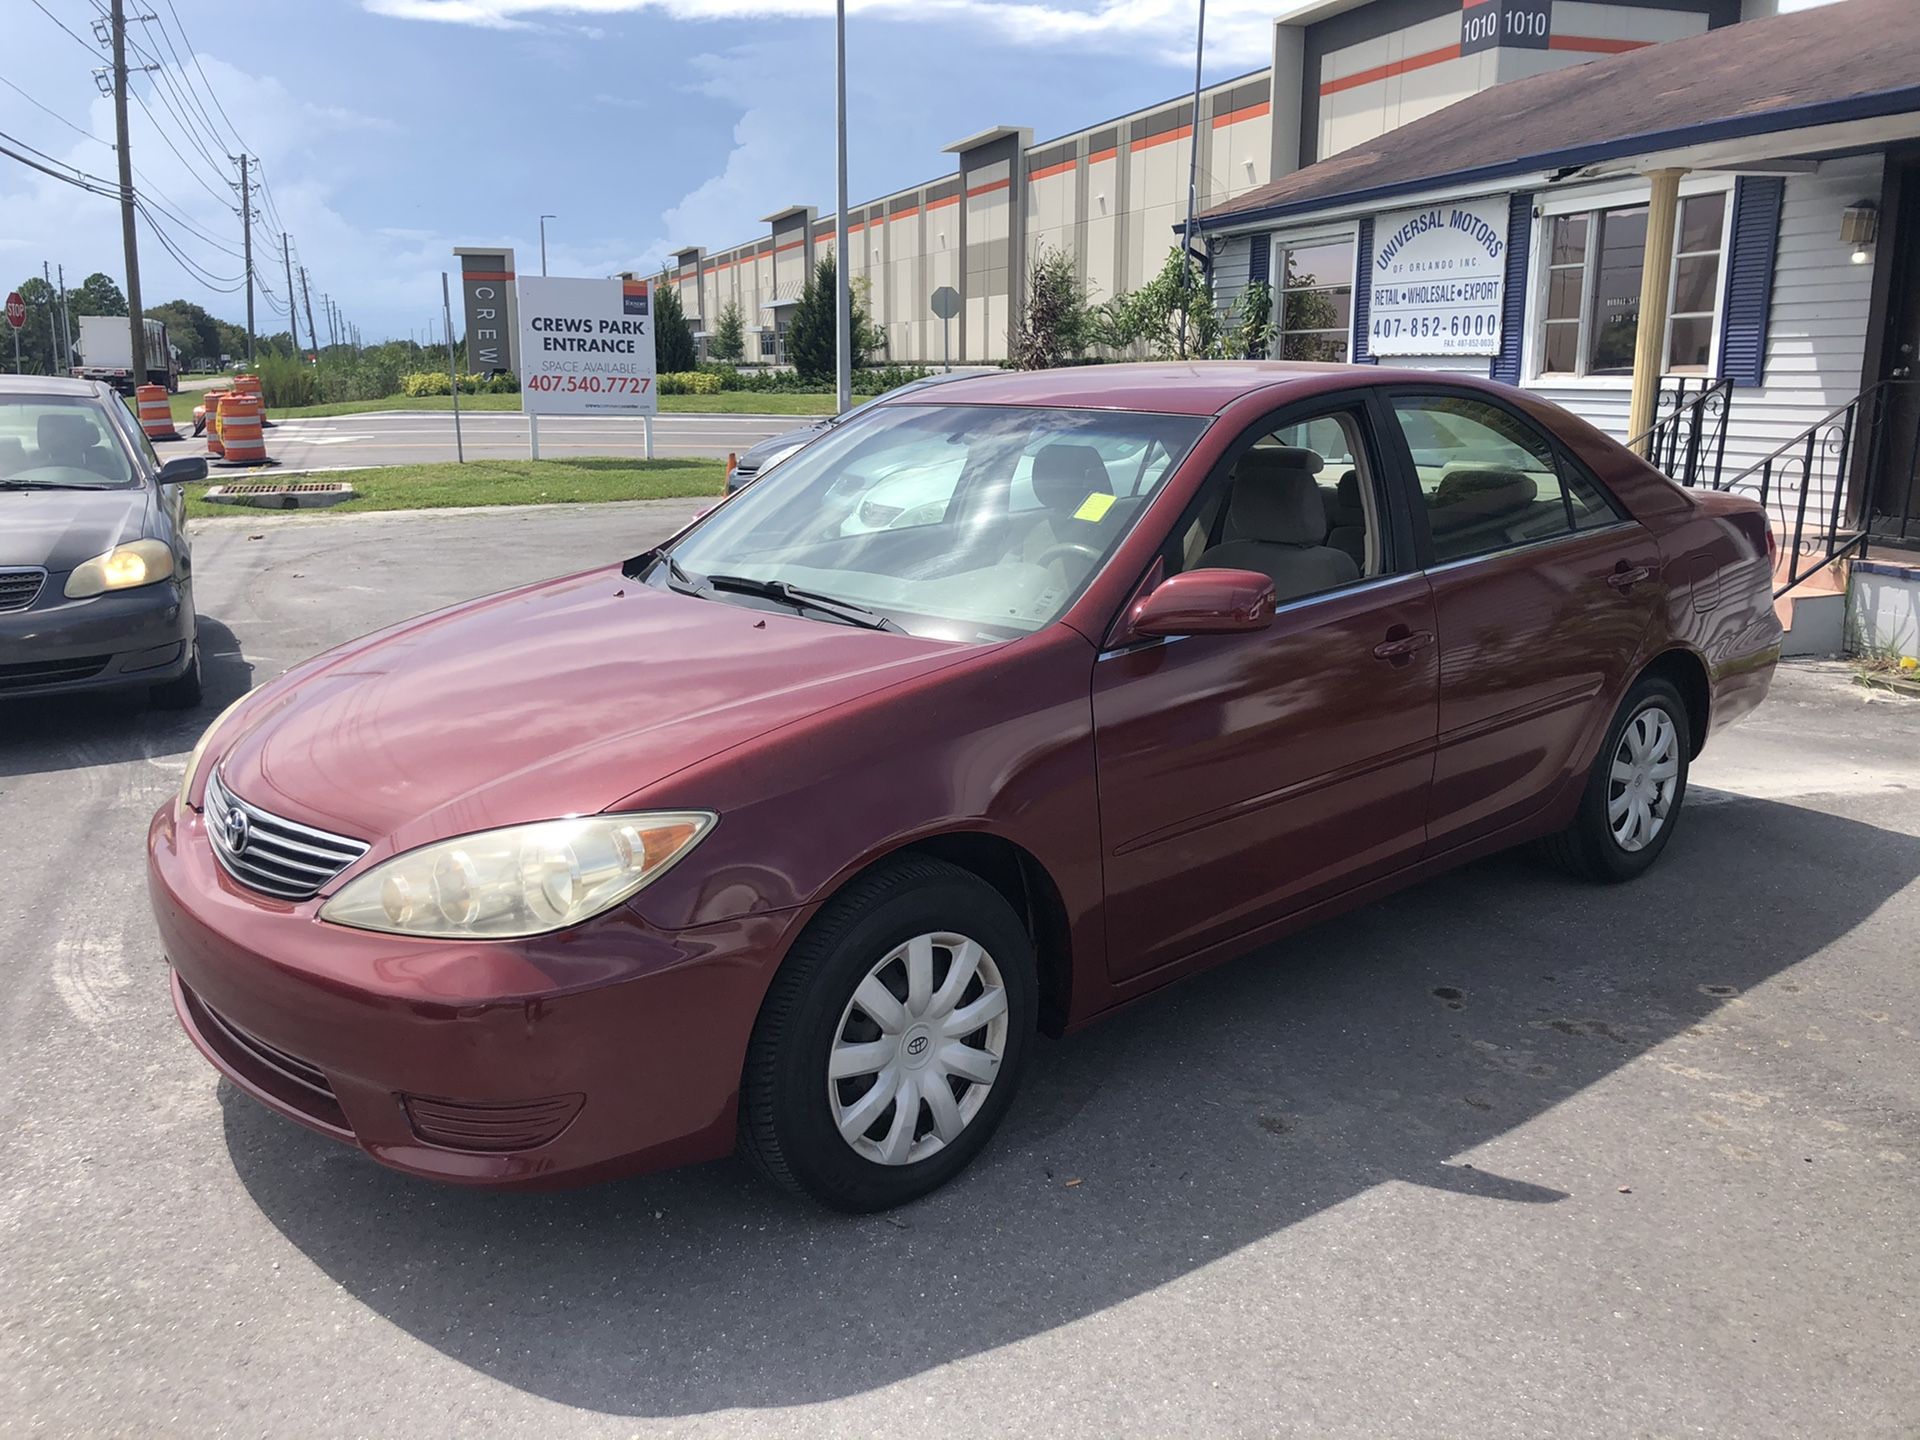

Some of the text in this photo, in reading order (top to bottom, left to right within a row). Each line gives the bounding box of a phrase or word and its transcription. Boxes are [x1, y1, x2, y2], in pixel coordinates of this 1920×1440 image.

[1464, 12, 1497, 43] 1010
[1505, 10, 1546, 36] 1010
[1376, 209, 1503, 271] UNIVERSAL MOTORS
[1393, 264, 1403, 274] OF
[1409, 259, 1454, 272] ORLANDO
[1374, 281, 1499, 306] RETAIL WHOLESALE EXPORT
[7, 303, 25, 317] STOP
[531, 317, 645, 335] CREWS PARK
[1373, 314, 1496, 338] 407-852-6000
[543, 337, 635, 354] ENTRANCE
[541, 360, 637, 374] SPACE AVAILABLE
[528, 375, 651, 394] 407.540.7727
